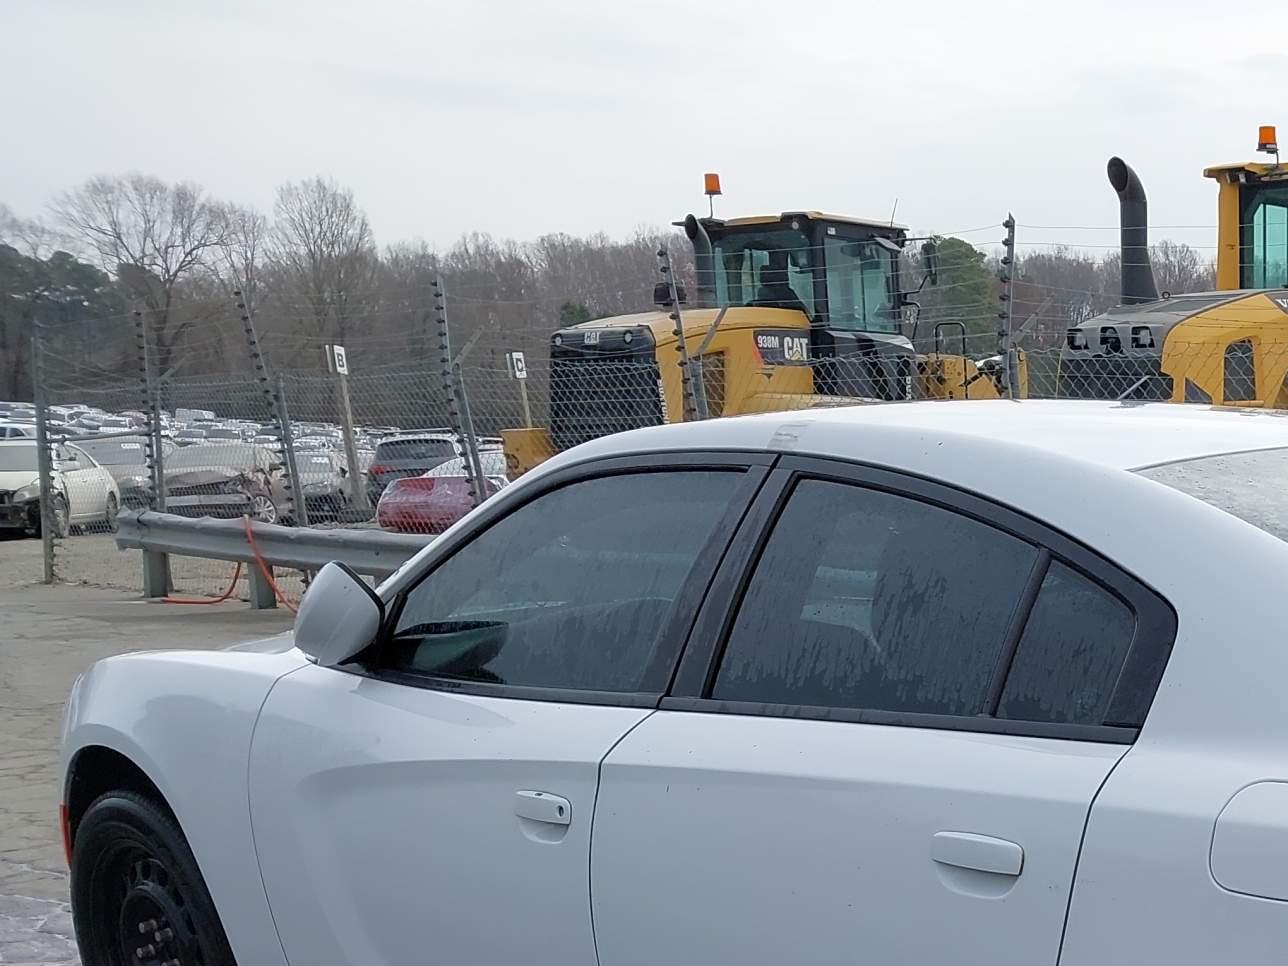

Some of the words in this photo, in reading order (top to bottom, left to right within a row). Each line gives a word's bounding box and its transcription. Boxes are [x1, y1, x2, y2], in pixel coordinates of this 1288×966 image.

[757, 335, 779, 348] 938M
[783, 336, 808, 361] CAT
[335, 351, 345, 368] B
